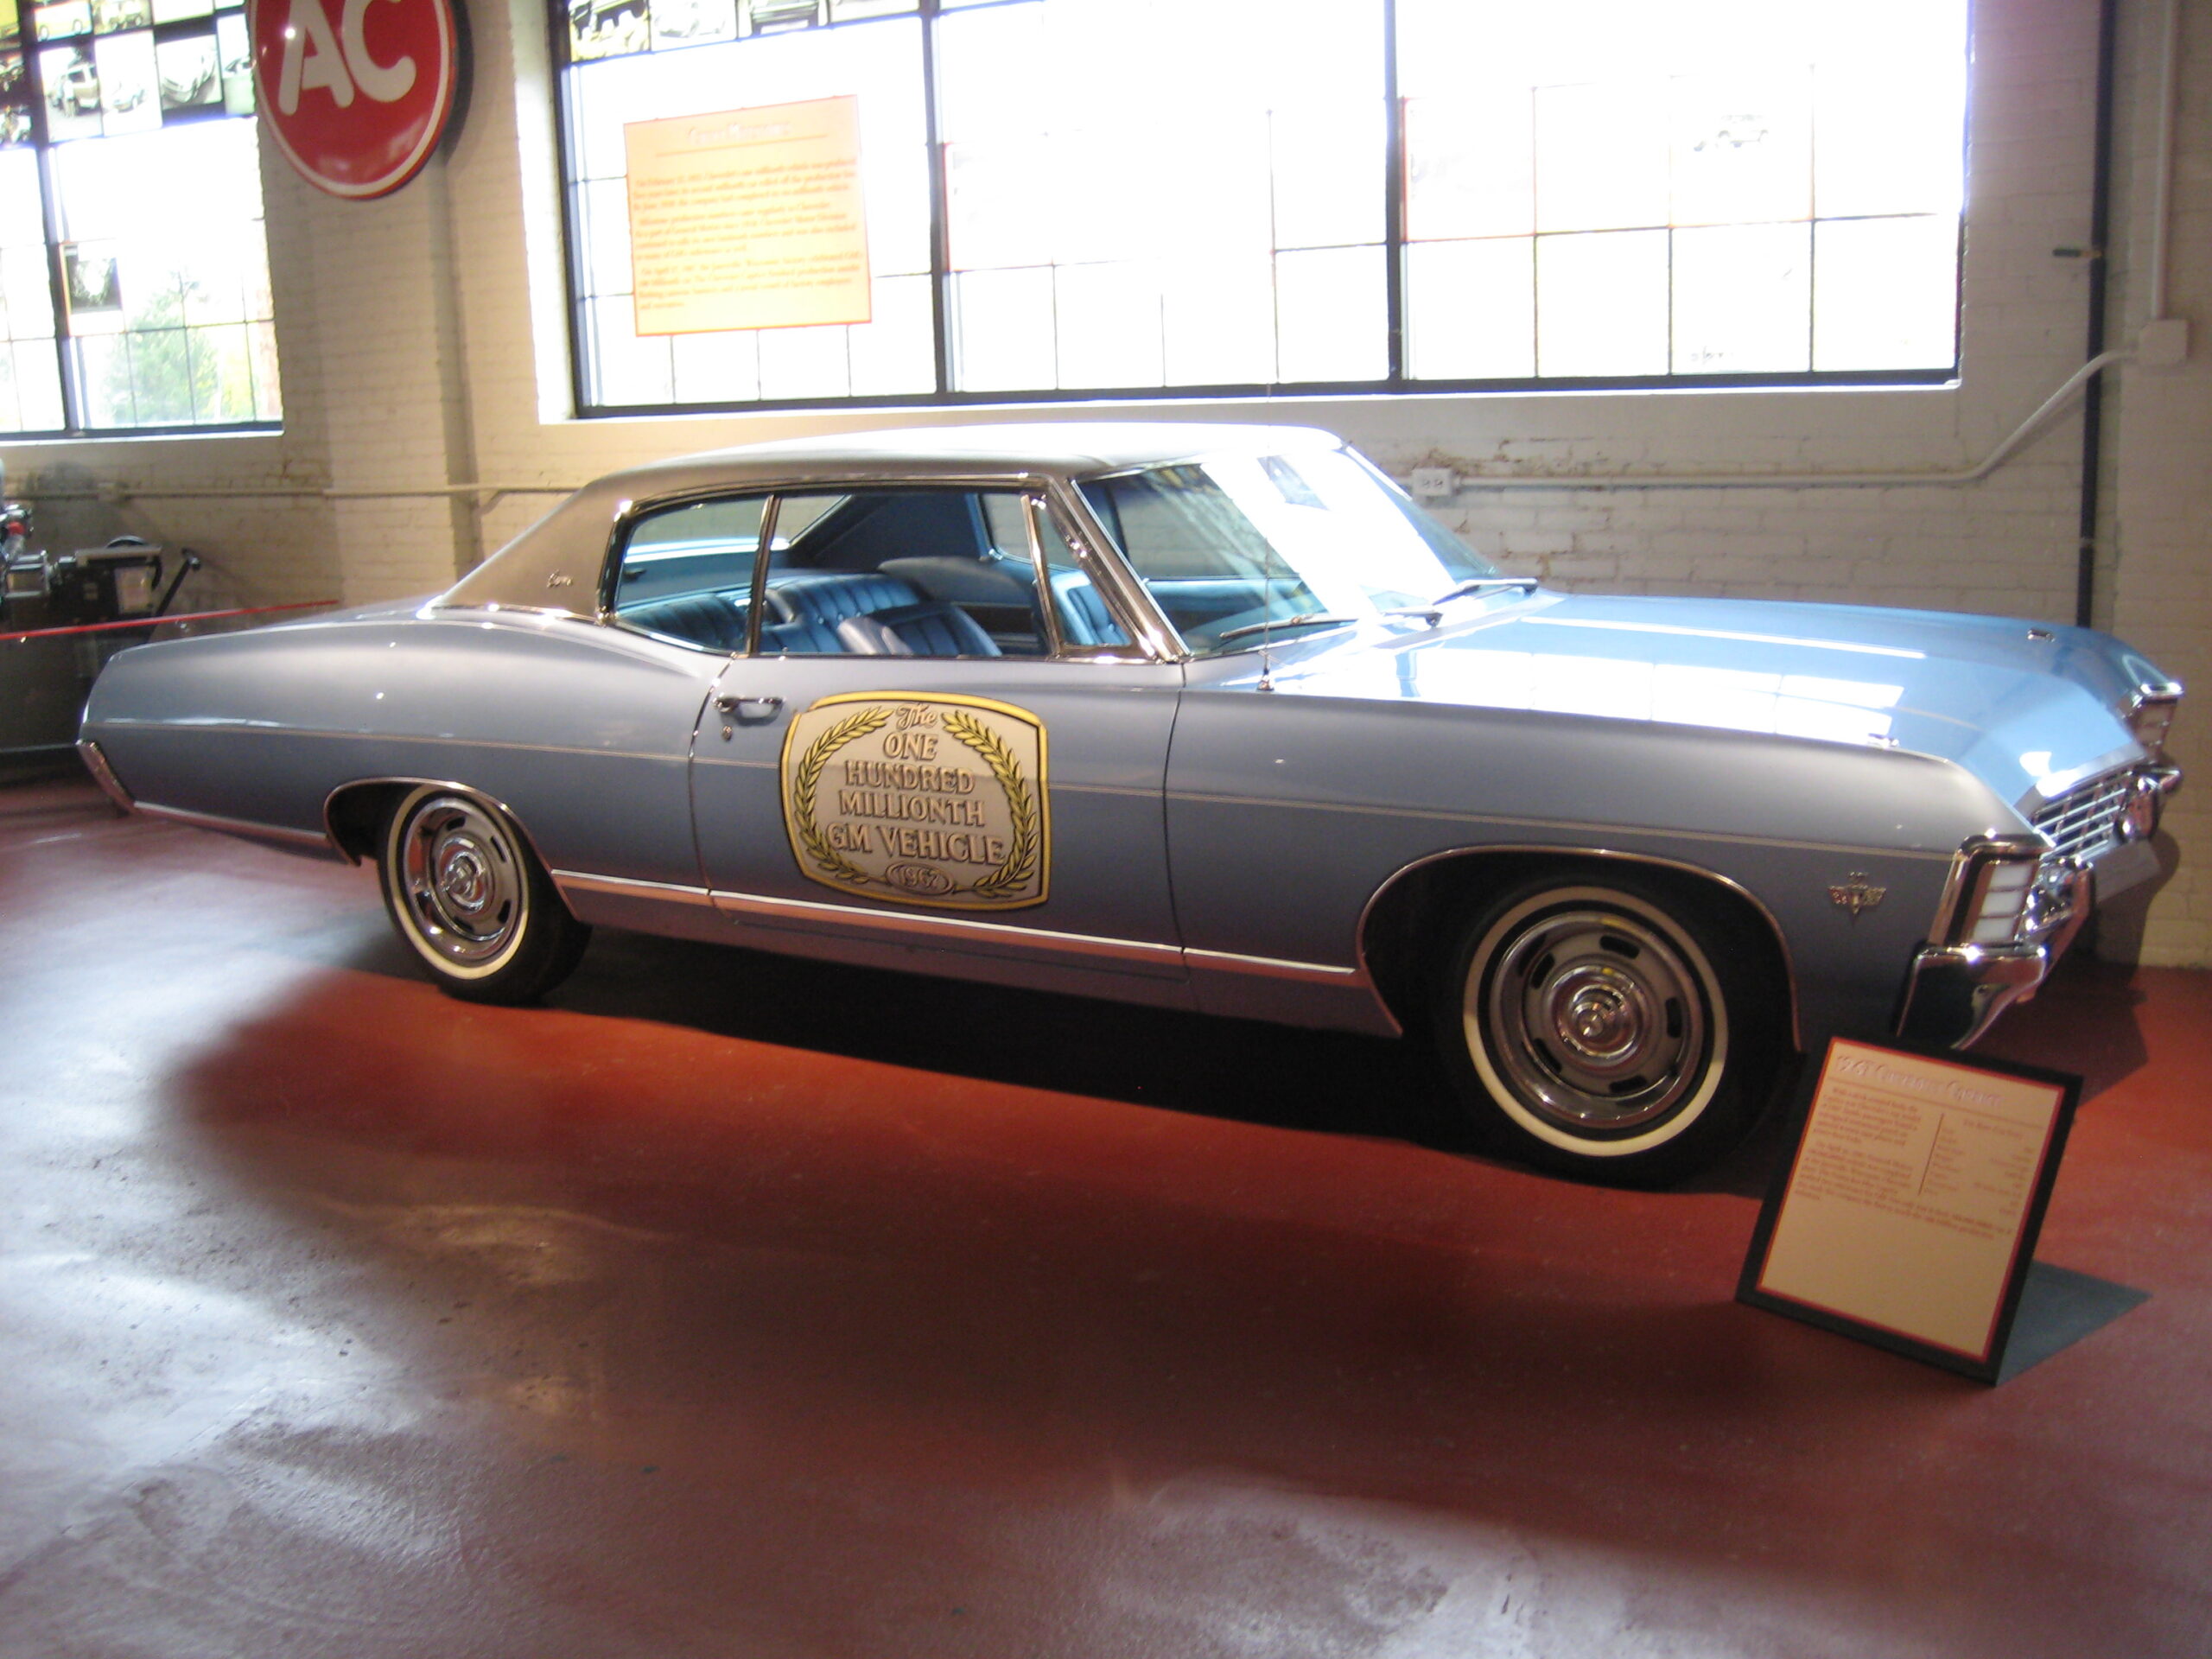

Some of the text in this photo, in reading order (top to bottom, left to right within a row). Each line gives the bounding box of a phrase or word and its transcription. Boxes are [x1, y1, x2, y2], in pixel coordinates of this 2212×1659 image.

[278, 0, 416, 116] AC
[896, 702, 938, 731] The
[883, 732, 938, 761] ONE
[844, 759, 976, 795] HUNDRED
[838, 789, 985, 827] MILLIONTH
[826, 823, 1007, 866] GM VEHICLE
[898, 865, 943, 889] 1967
